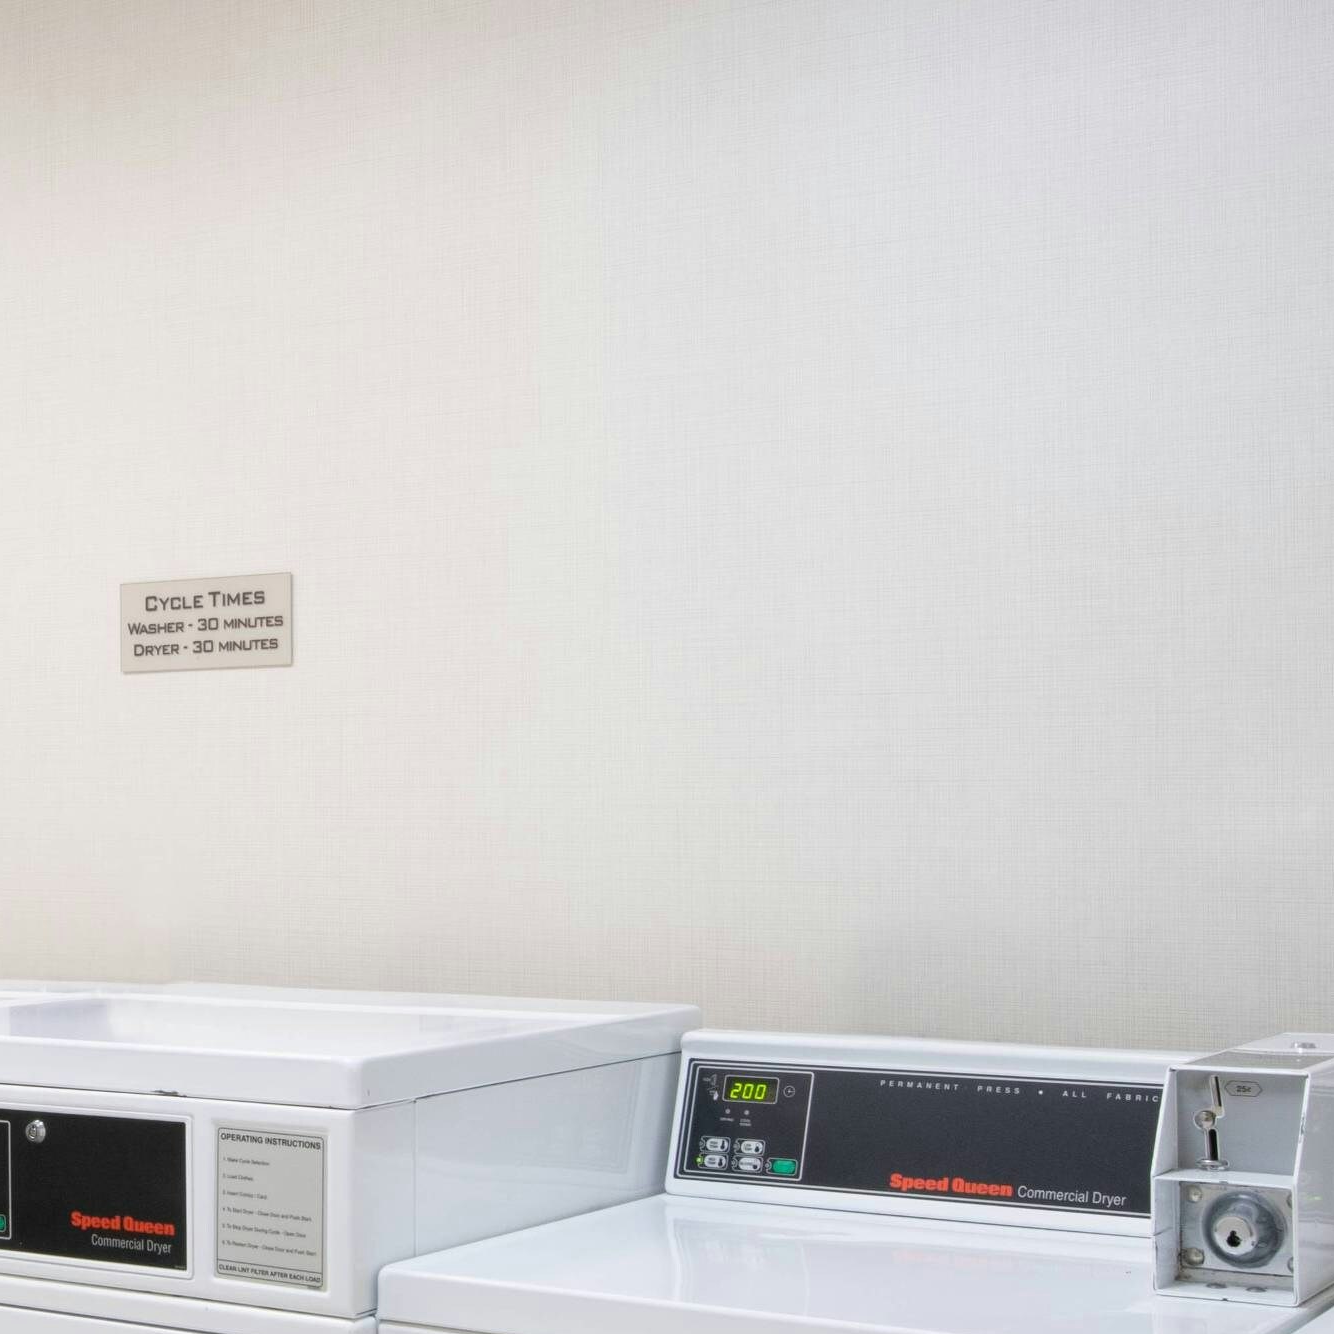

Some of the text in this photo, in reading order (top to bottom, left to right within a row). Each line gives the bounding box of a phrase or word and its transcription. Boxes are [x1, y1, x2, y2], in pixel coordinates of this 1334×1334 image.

[145, 590, 265, 612] CYCLE TIMES
[127, 622, 184, 636] WASHER
[197, 618, 219, 632] 30
[223, 616, 284, 629] MINUTES
[134, 644, 179, 657] DRYER
[193, 640, 214, 654] 30
[219, 638, 279, 652] MINUTES
[730, 1083, 767, 1100] 200
[879, 1079, 1160, 1103] PERMANENT PRESS ALL FABRIC
[221, 1133, 321, 1150] OPERATING INSTRUCTIONS
[889, 1173, 1127, 1208] Speed Queen Commercial Dryer
[71, 1211, 175, 1236] Speed Queen
[91, 1234, 171, 1255] Commercial Dryer
[251, 1268, 269, 1276] FILTER
